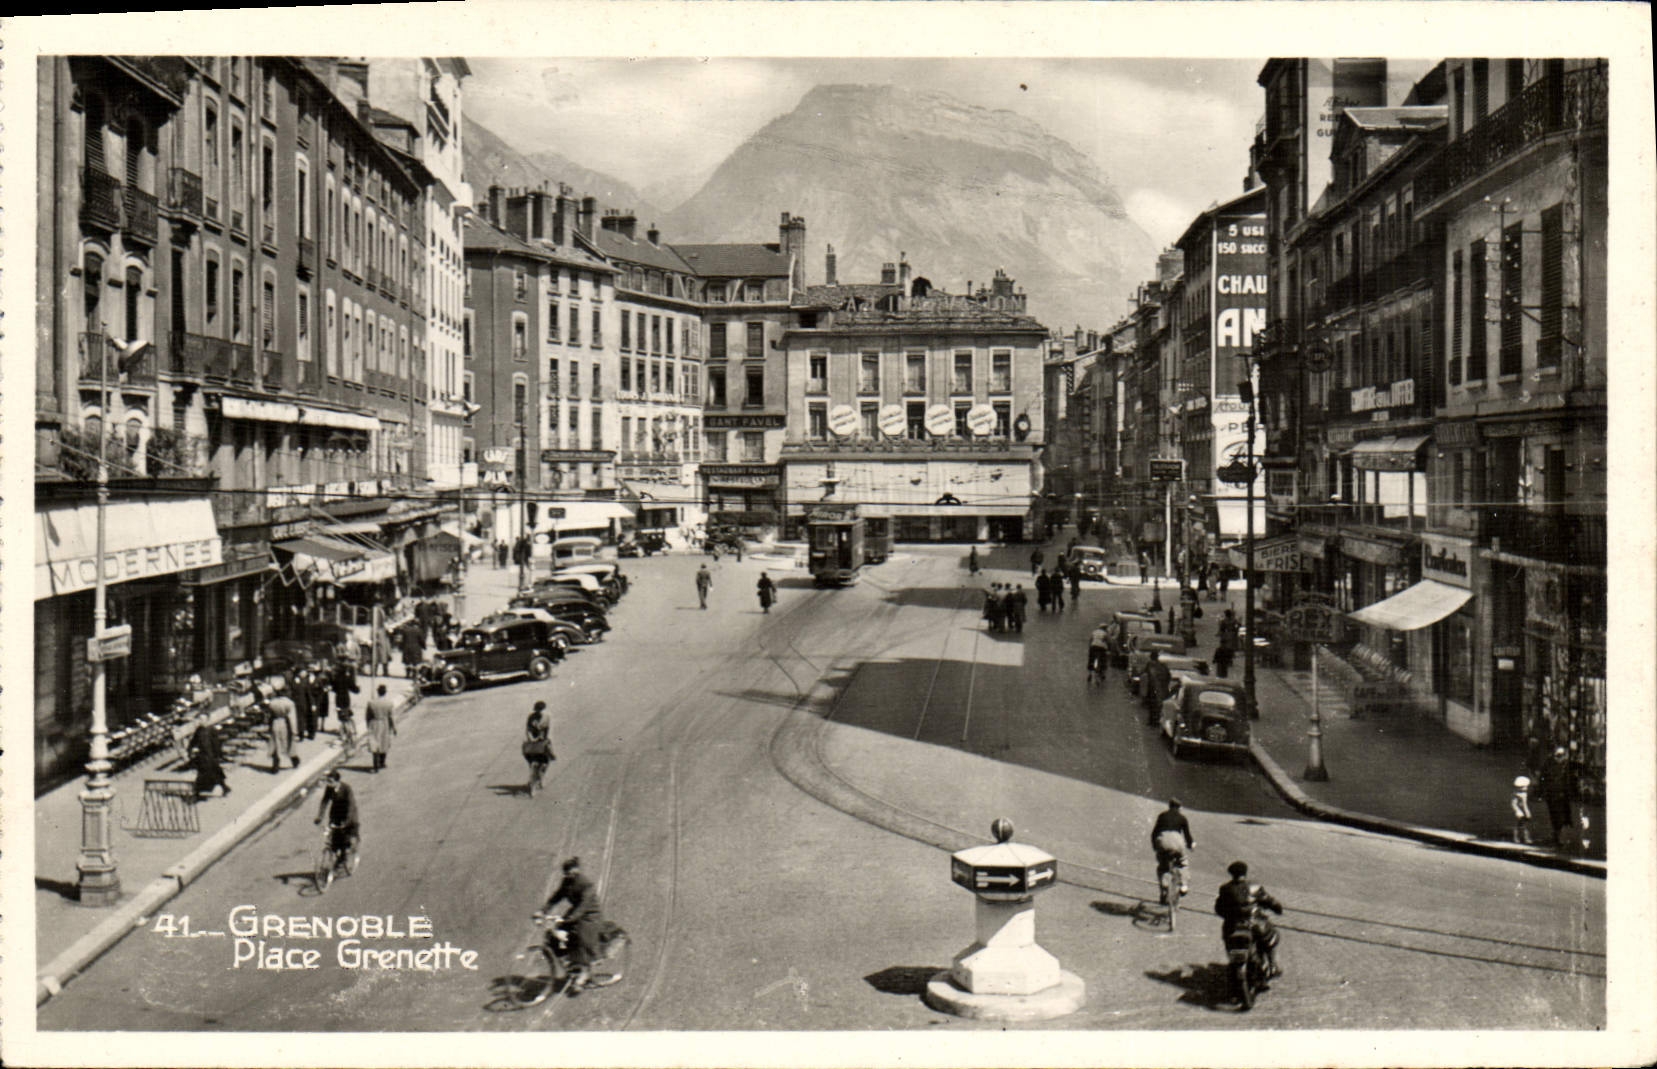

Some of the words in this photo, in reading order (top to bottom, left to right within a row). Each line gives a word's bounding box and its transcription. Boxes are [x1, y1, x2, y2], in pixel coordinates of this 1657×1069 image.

[1228, 224, 1238, 237] 5
[1218, 242, 1237, 254] 150
[1218, 275, 1268, 294] CHAU
[50, 543, 213, 589] MODERNES
